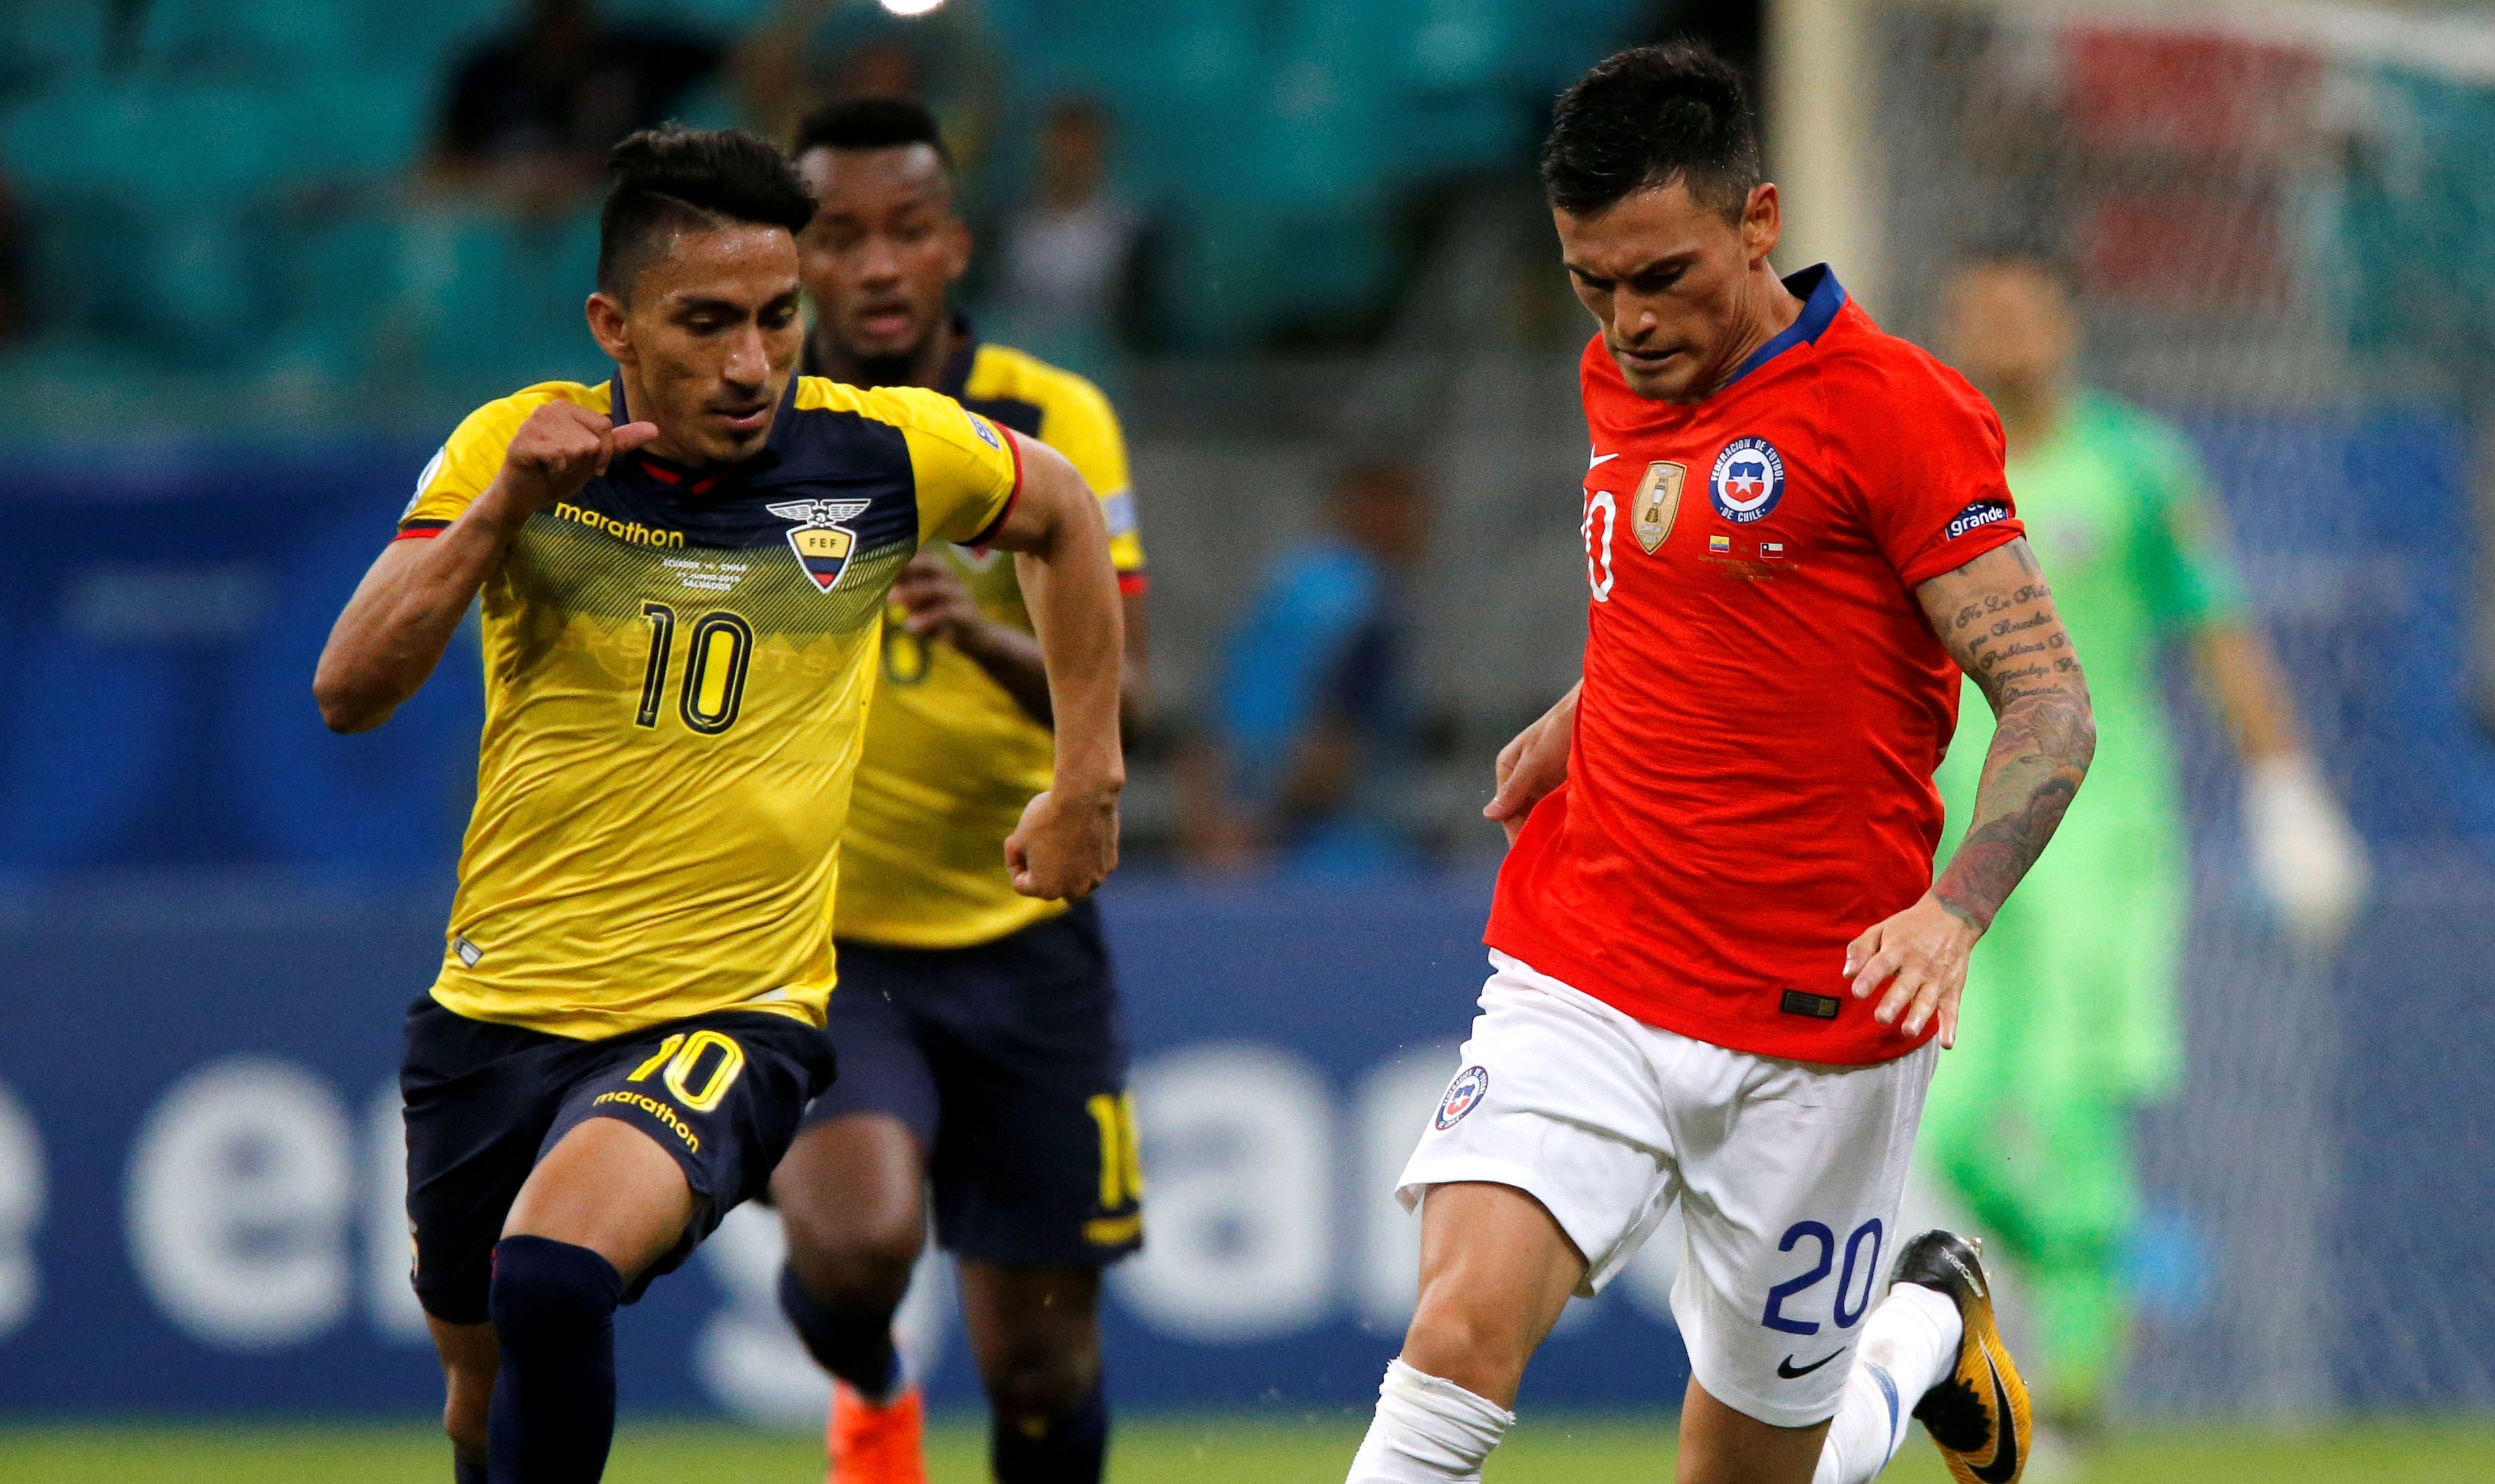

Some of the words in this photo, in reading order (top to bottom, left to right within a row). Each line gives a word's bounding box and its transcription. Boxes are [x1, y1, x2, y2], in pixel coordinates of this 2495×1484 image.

[1710, 438, 1752, 482] FEDERACION
[1754, 439, 1767, 451] DE
[1765, 447, 1784, 483] FUTBOL
[554, 502, 684, 548] marathon
[1721, 506, 1734, 520] DE
[1737, 508, 1763, 522] CHILE
[1950, 506, 2004, 537] grande
[664, 559, 700, 569] ECUADOR
[721, 563, 747, 571] CHILE
[809, 538, 836, 548] FEF
[1580, 486, 1617, 603] 0
[682, 578, 731, 591] SALVADOR
[633, 599, 755, 738] 10
[626, 1029, 745, 1112] 10
[593, 1091, 700, 1154] marathon
[1761, 1218, 1883, 1335] 20
